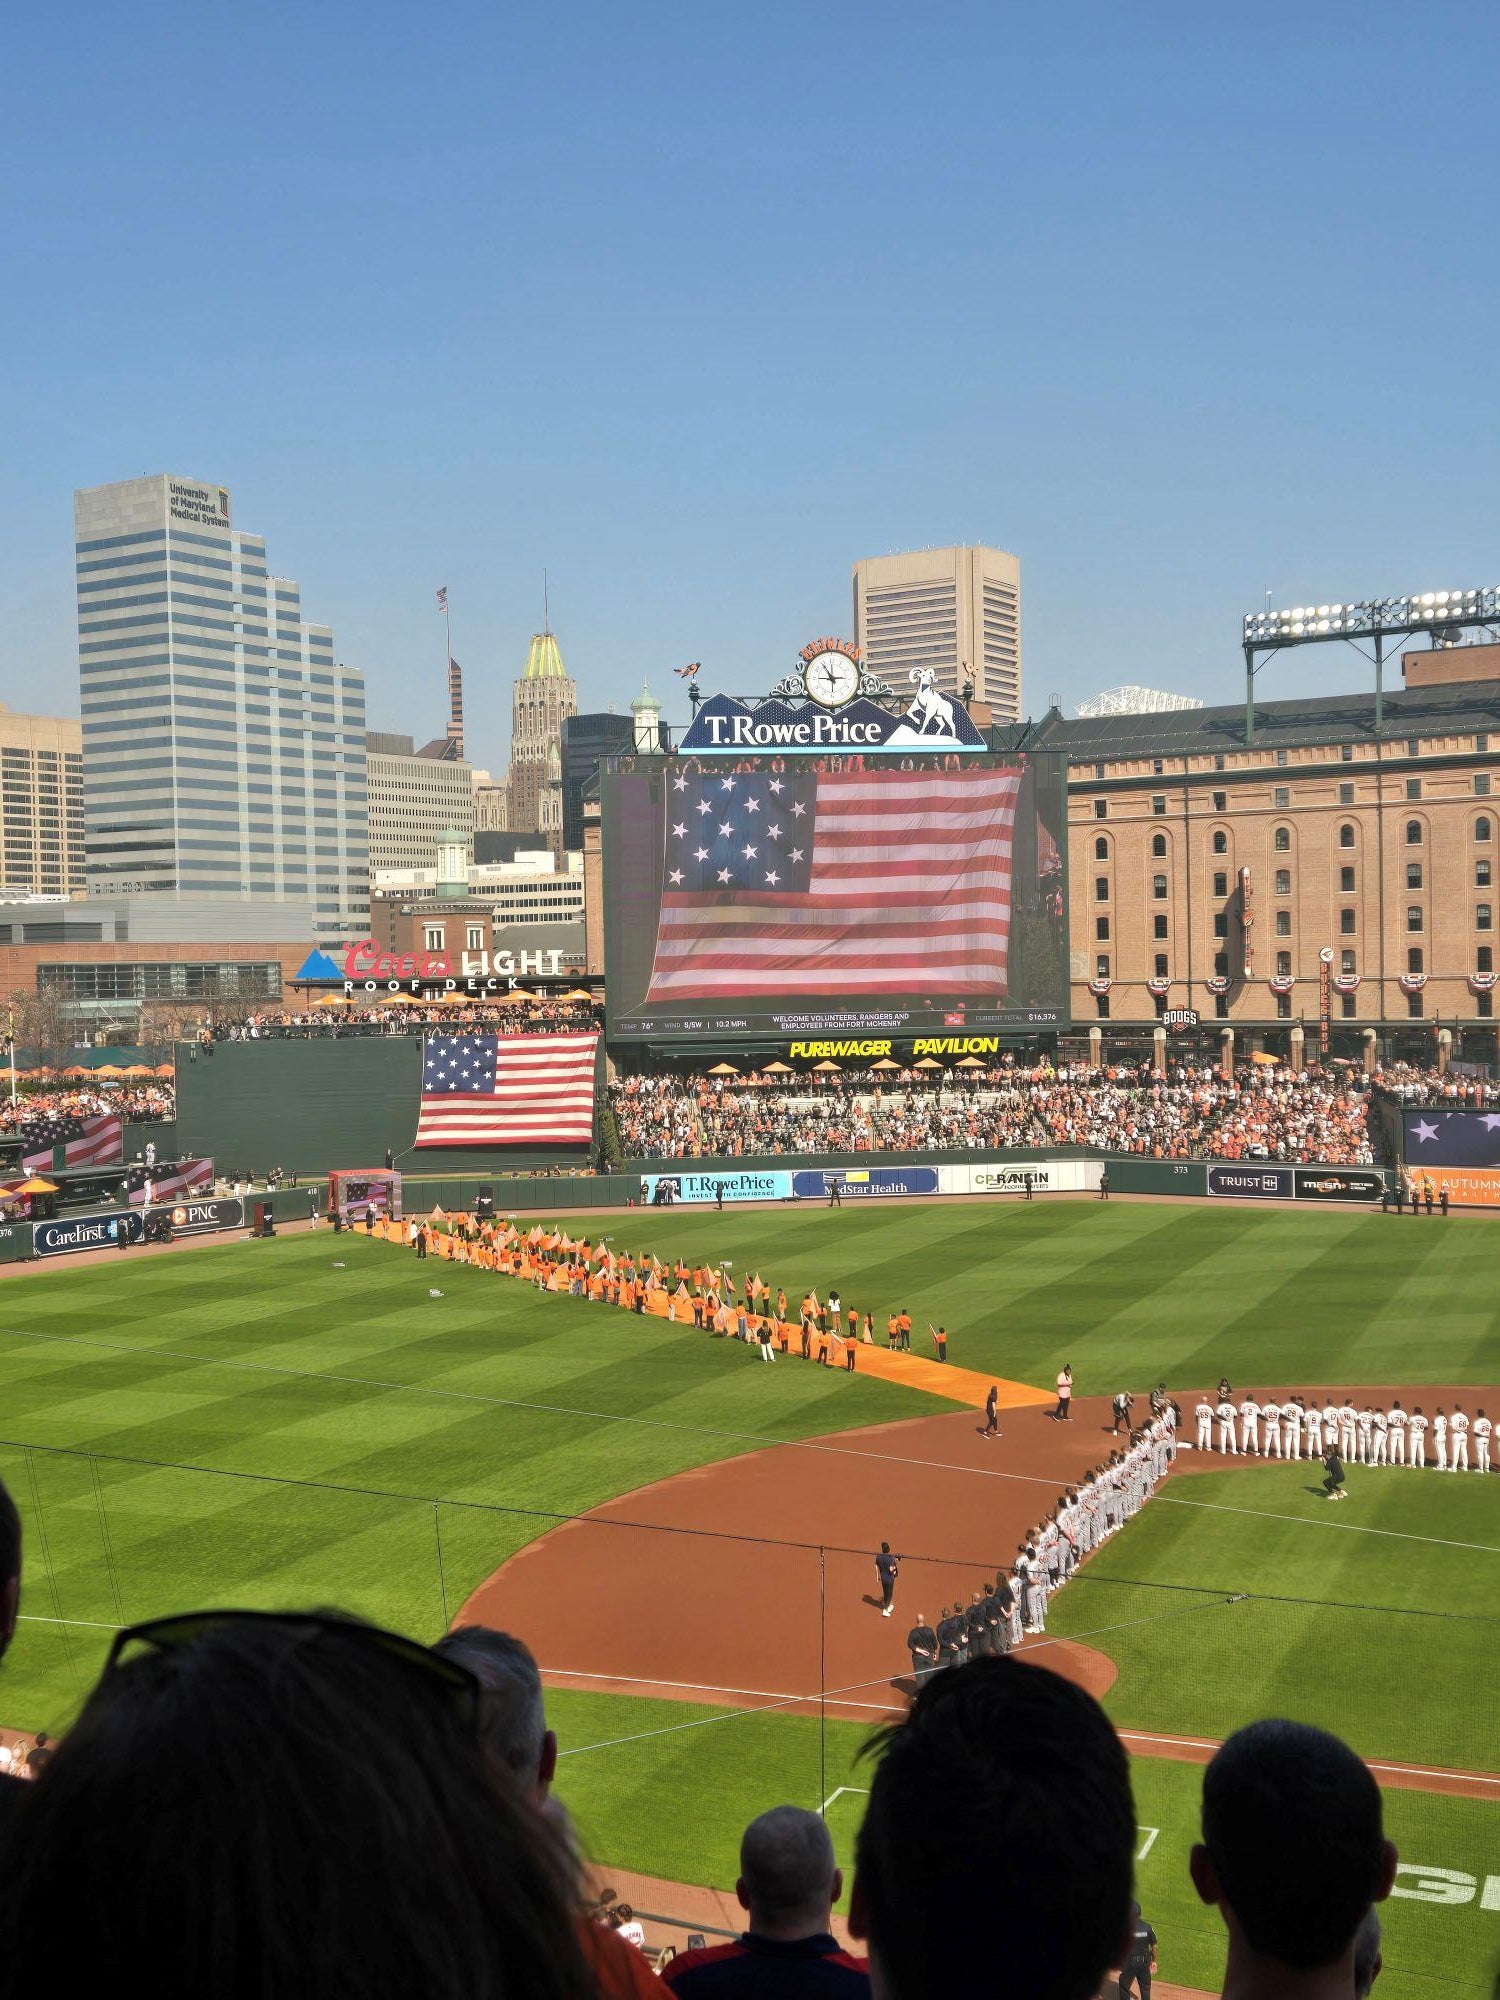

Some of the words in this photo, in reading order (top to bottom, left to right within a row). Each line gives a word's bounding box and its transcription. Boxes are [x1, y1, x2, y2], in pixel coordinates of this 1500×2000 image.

[170, 483, 208, 502] University
[171, 496, 179, 505] of
[180, 497, 215, 513] Maryland
[170, 506, 200, 522] Medical
[202, 513, 229, 528] System
[799, 636, 862, 661] ORIOLES
[342, 937, 456, 979] Coors
[461, 949, 564, 976] LIGHT
[343, 979, 420, 992] ROOF
[446, 977, 519, 990] DECK
[789, 1040, 892, 1058] PUREWAGER
[912, 1037, 999, 1054] PAVILION
[1173, 1166, 1188, 1174] 373
[740, 1175, 774, 1190] Price
[824, 1184, 869, 1195] MdStar
[871, 1182, 908, 1193] Health
[1219, 1176, 1260, 1187] TRUIST
[188, 1204, 218, 1221] PNC
[46, 1223, 106, 1247] CareFirst
